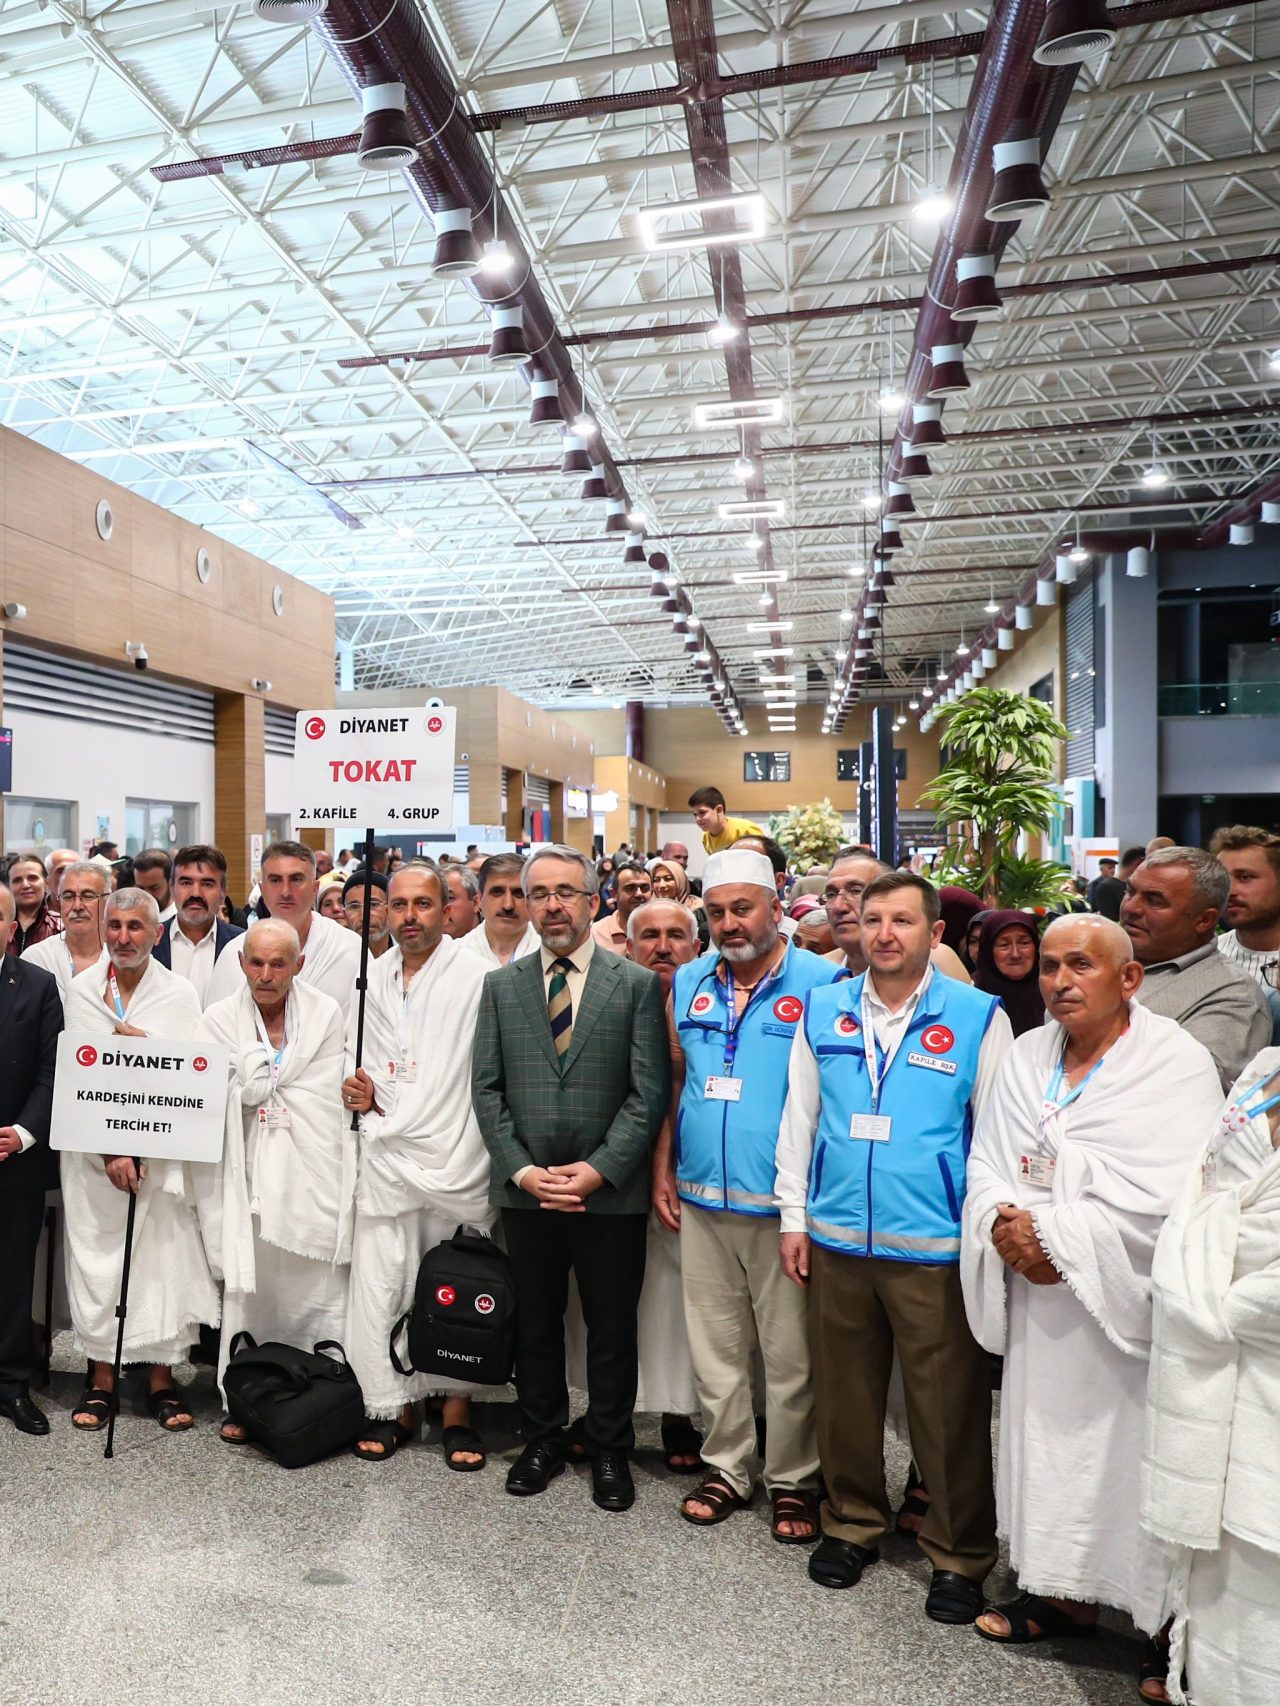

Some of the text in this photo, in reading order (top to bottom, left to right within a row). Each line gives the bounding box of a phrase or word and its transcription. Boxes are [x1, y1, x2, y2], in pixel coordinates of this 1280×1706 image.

[339, 716, 409, 734] DİYANET
[328, 759, 417, 783] TOKAT
[299, 805, 357, 820] 2. KAFİLE
[387, 808, 440, 820] 4. GRUP
[102, 1050, 185, 1071] DİYANET
[77, 1090, 204, 1109] KARDEŞİNİ KENDİNE
[105, 1118, 172, 1134] TERCİH ET!
